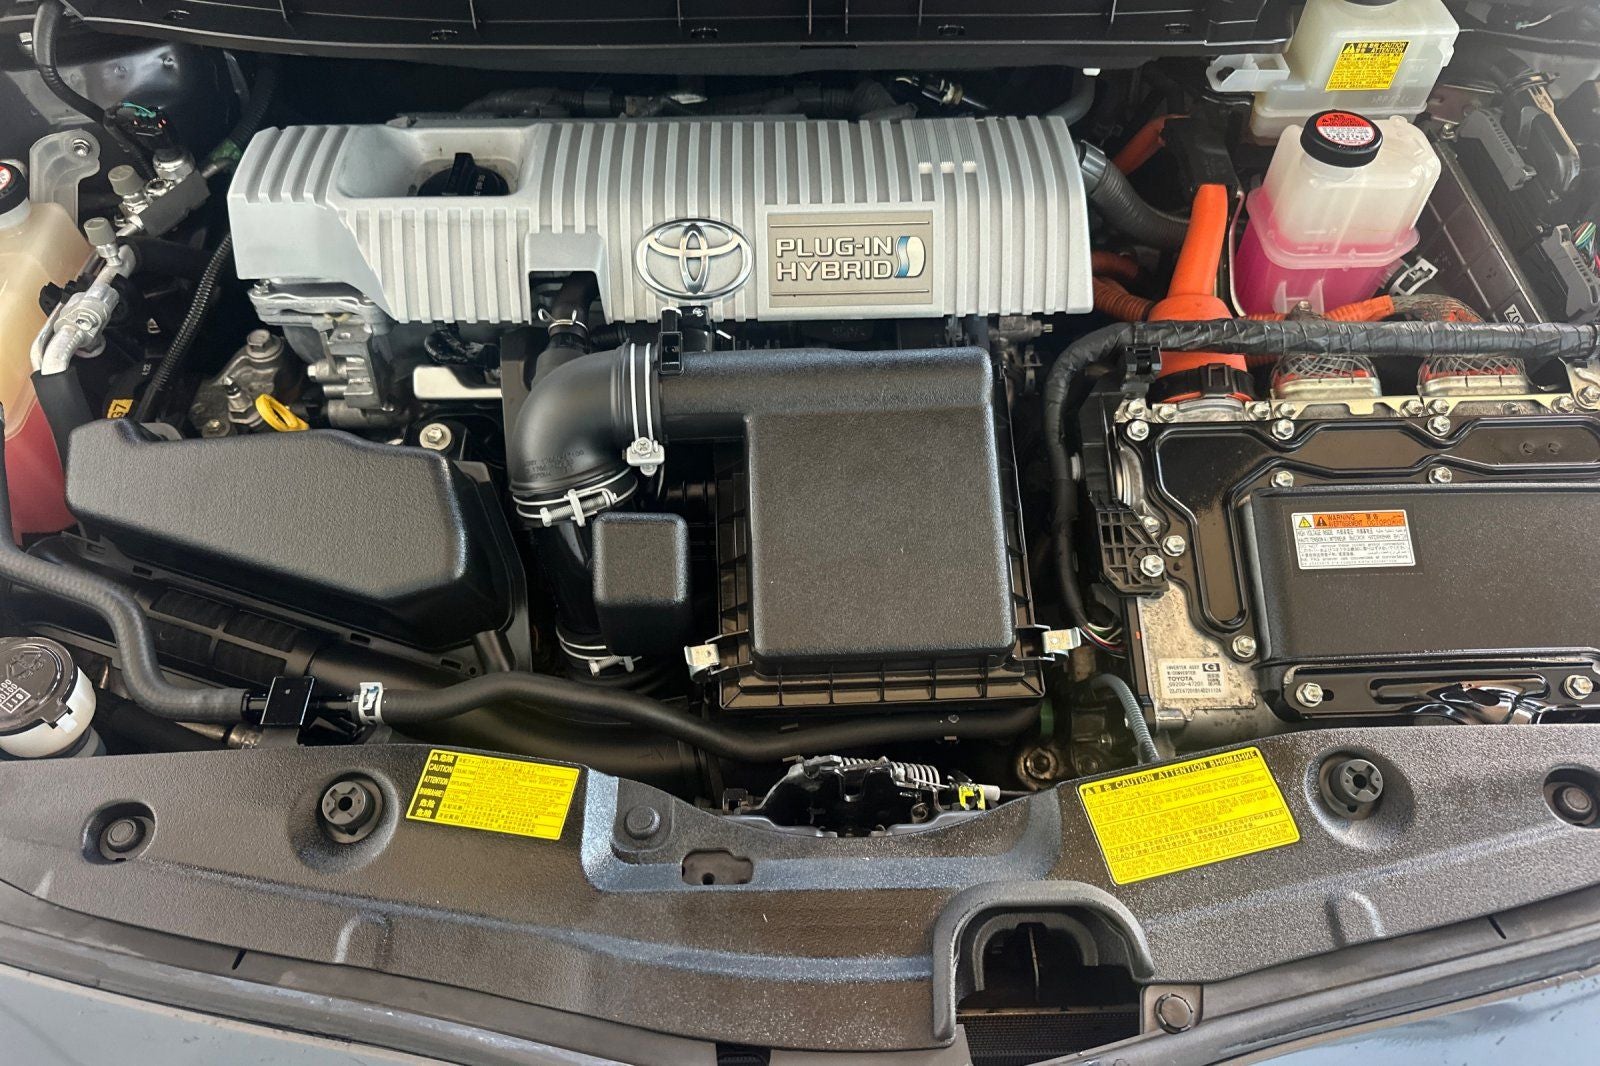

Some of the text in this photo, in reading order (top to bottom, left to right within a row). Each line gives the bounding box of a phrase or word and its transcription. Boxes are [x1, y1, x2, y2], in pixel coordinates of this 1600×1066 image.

[775, 235, 893, 257] PLUG-IN
[776, 260, 893, 281] HYBRID
[427, 763, 453, 773] CAUTION
[1115, 774, 1154, 788] CAUTION
[1157, 762, 1206, 778] ATTENTION
[423, 775, 449, 785] ATTENTION
